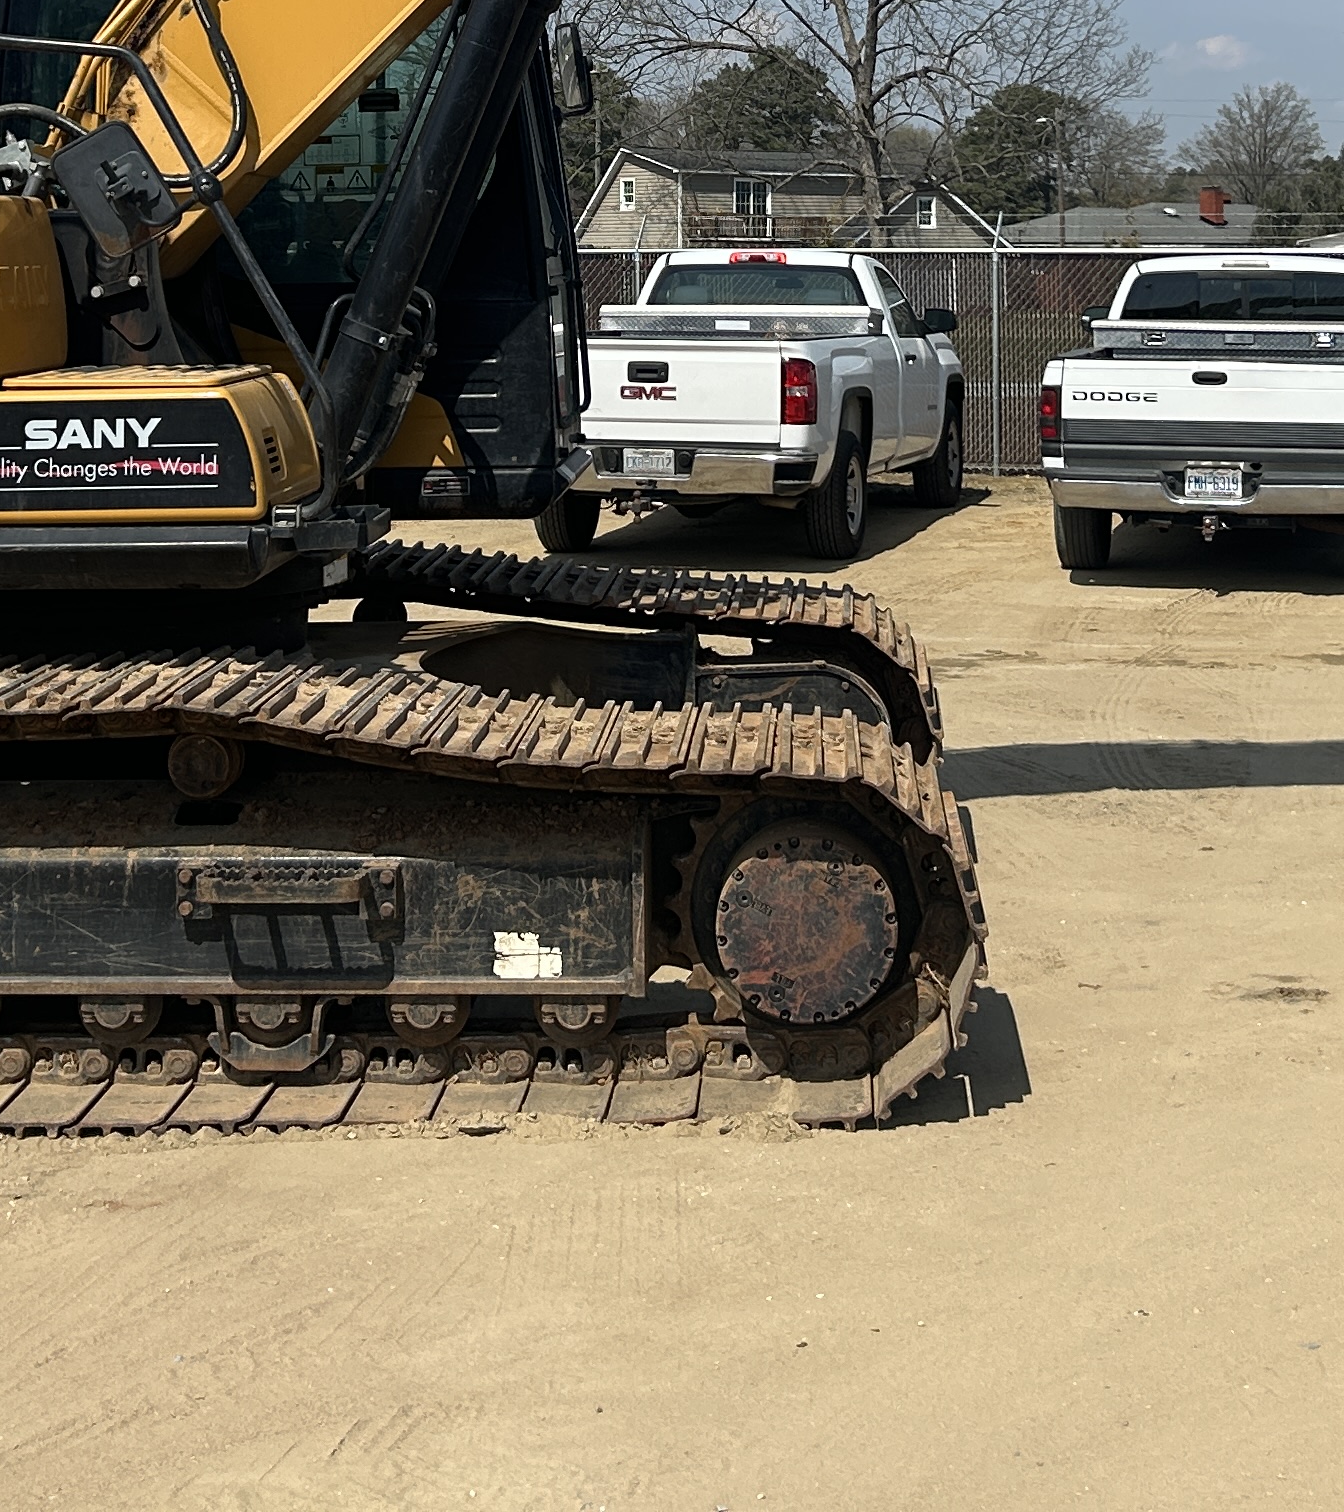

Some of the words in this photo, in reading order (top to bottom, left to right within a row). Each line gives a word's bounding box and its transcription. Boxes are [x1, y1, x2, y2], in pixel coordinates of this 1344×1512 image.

[620, 385, 676, 401] GMC
[1072, 391, 1158, 402] DODGE
[24, 418, 162, 450] SANY
[33, 456, 118, 481] Changes
[122, 458, 152, 475] the
[157, 454, 218, 475] World
